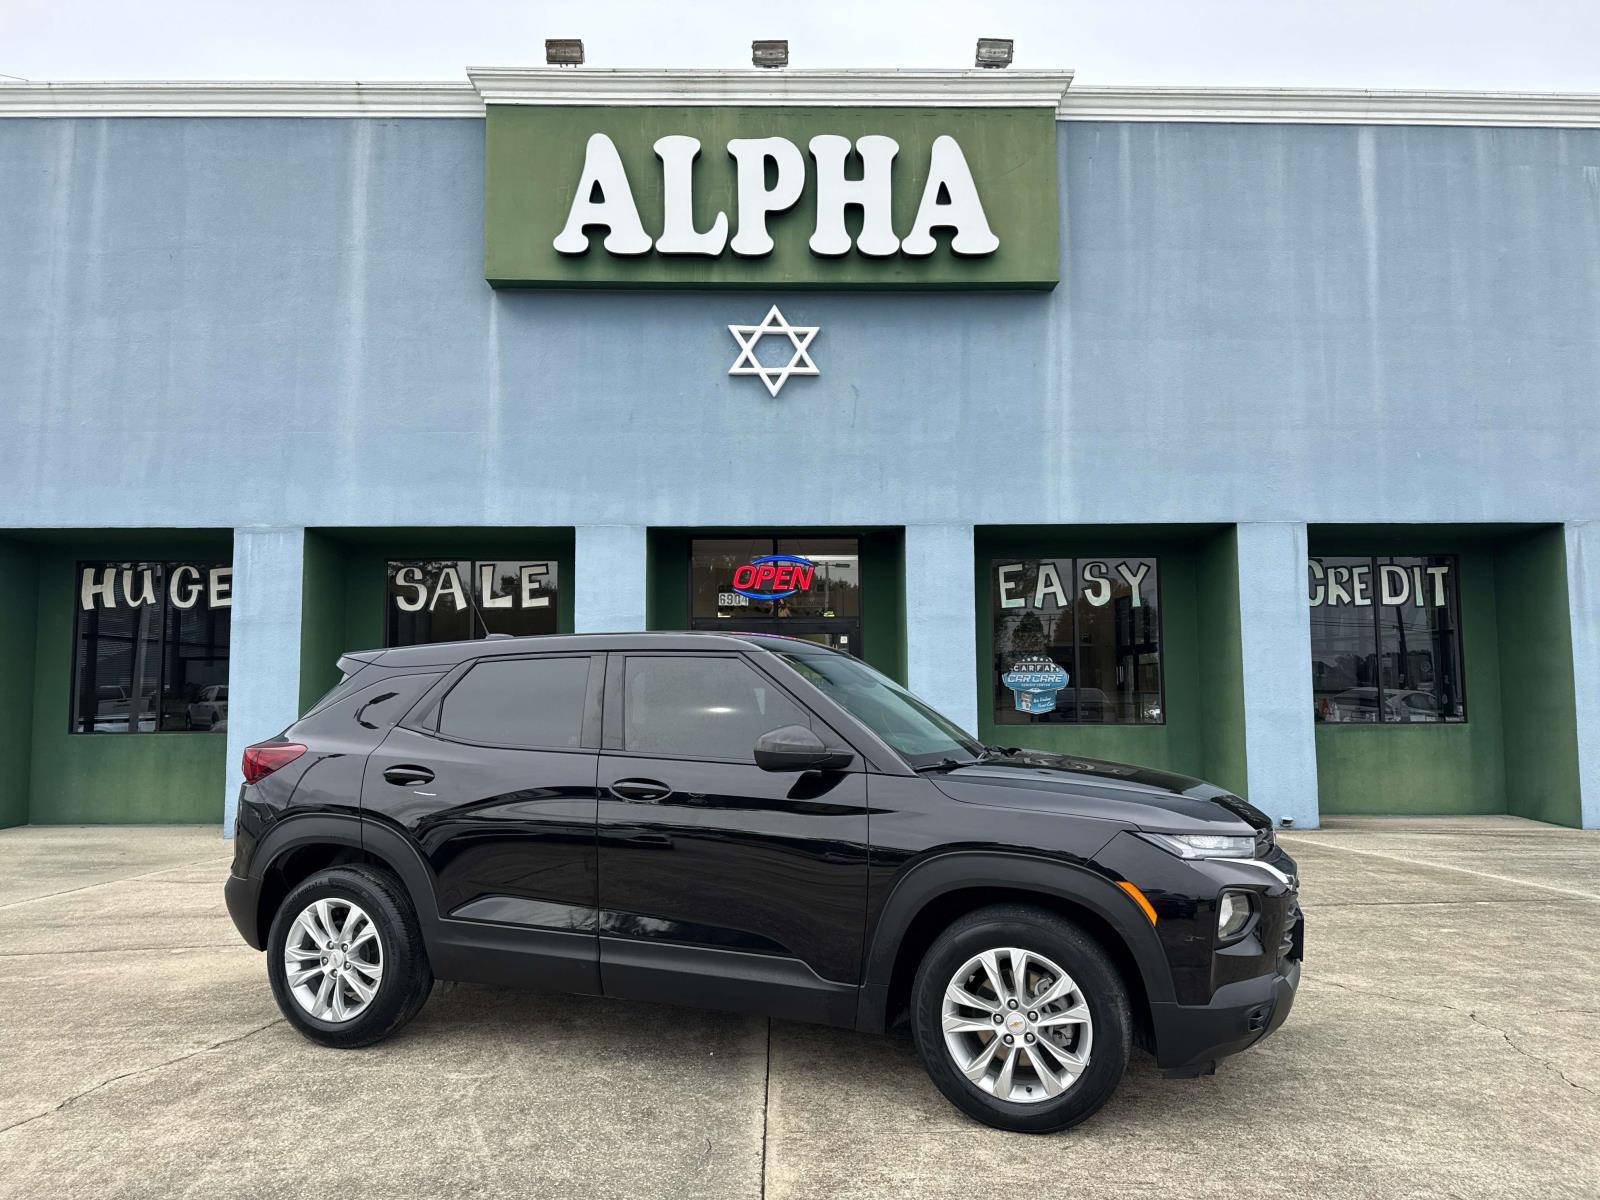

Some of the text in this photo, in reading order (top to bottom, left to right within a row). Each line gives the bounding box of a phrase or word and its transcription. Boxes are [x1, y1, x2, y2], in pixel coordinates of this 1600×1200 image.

[553, 132, 1000, 258] ALPHA
[81, 565, 232, 611] HUGE
[395, 563, 549, 612] SALE
[733, 565, 815, 590] OPEN
[998, 561, 1150, 609] EASY
[1308, 558, 1449, 607] CREDIT
[1008, 674, 1063, 683] CAR CARE
